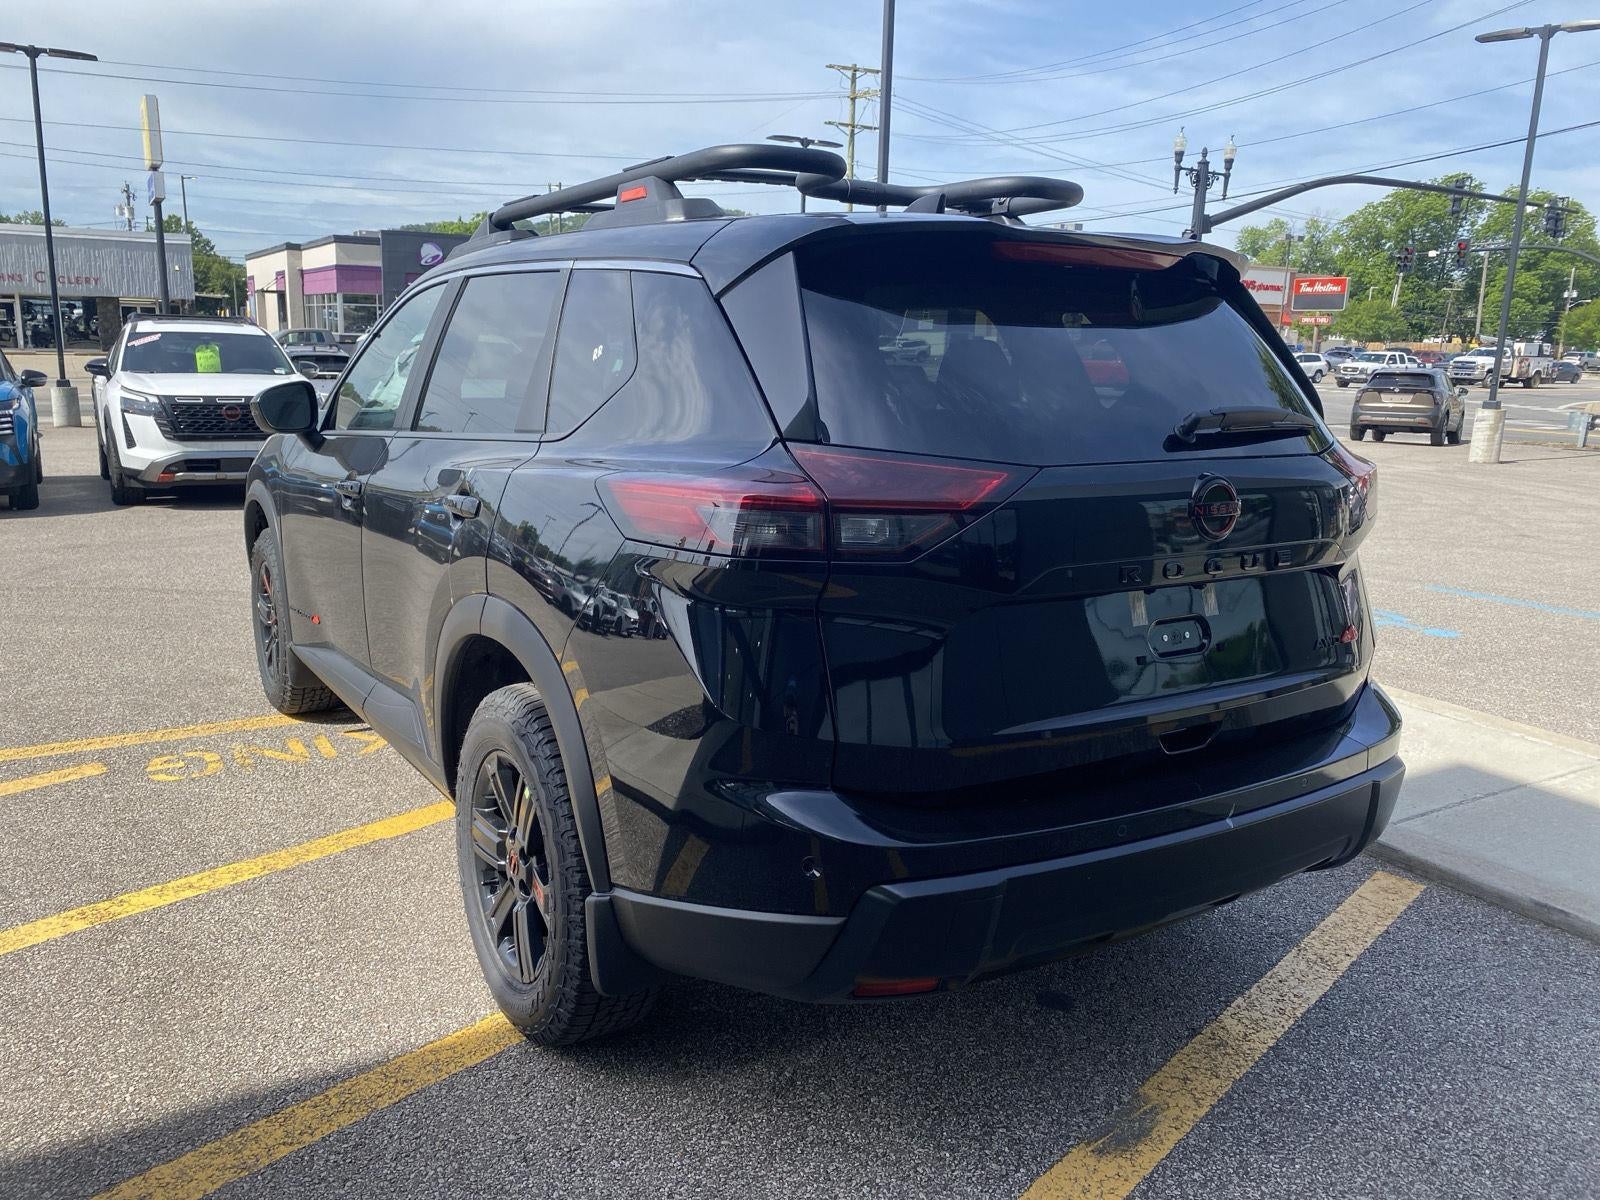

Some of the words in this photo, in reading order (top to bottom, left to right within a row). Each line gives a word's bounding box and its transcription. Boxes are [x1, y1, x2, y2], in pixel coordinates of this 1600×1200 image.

[34, 270, 100, 285] CCLERY
[1256, 283, 1284, 292] pharmac
[1300, 282, 1312, 293] Tim
[1313, 282, 1342, 292] Hortons
[1119, 549, 1293, 583] ROGUE
